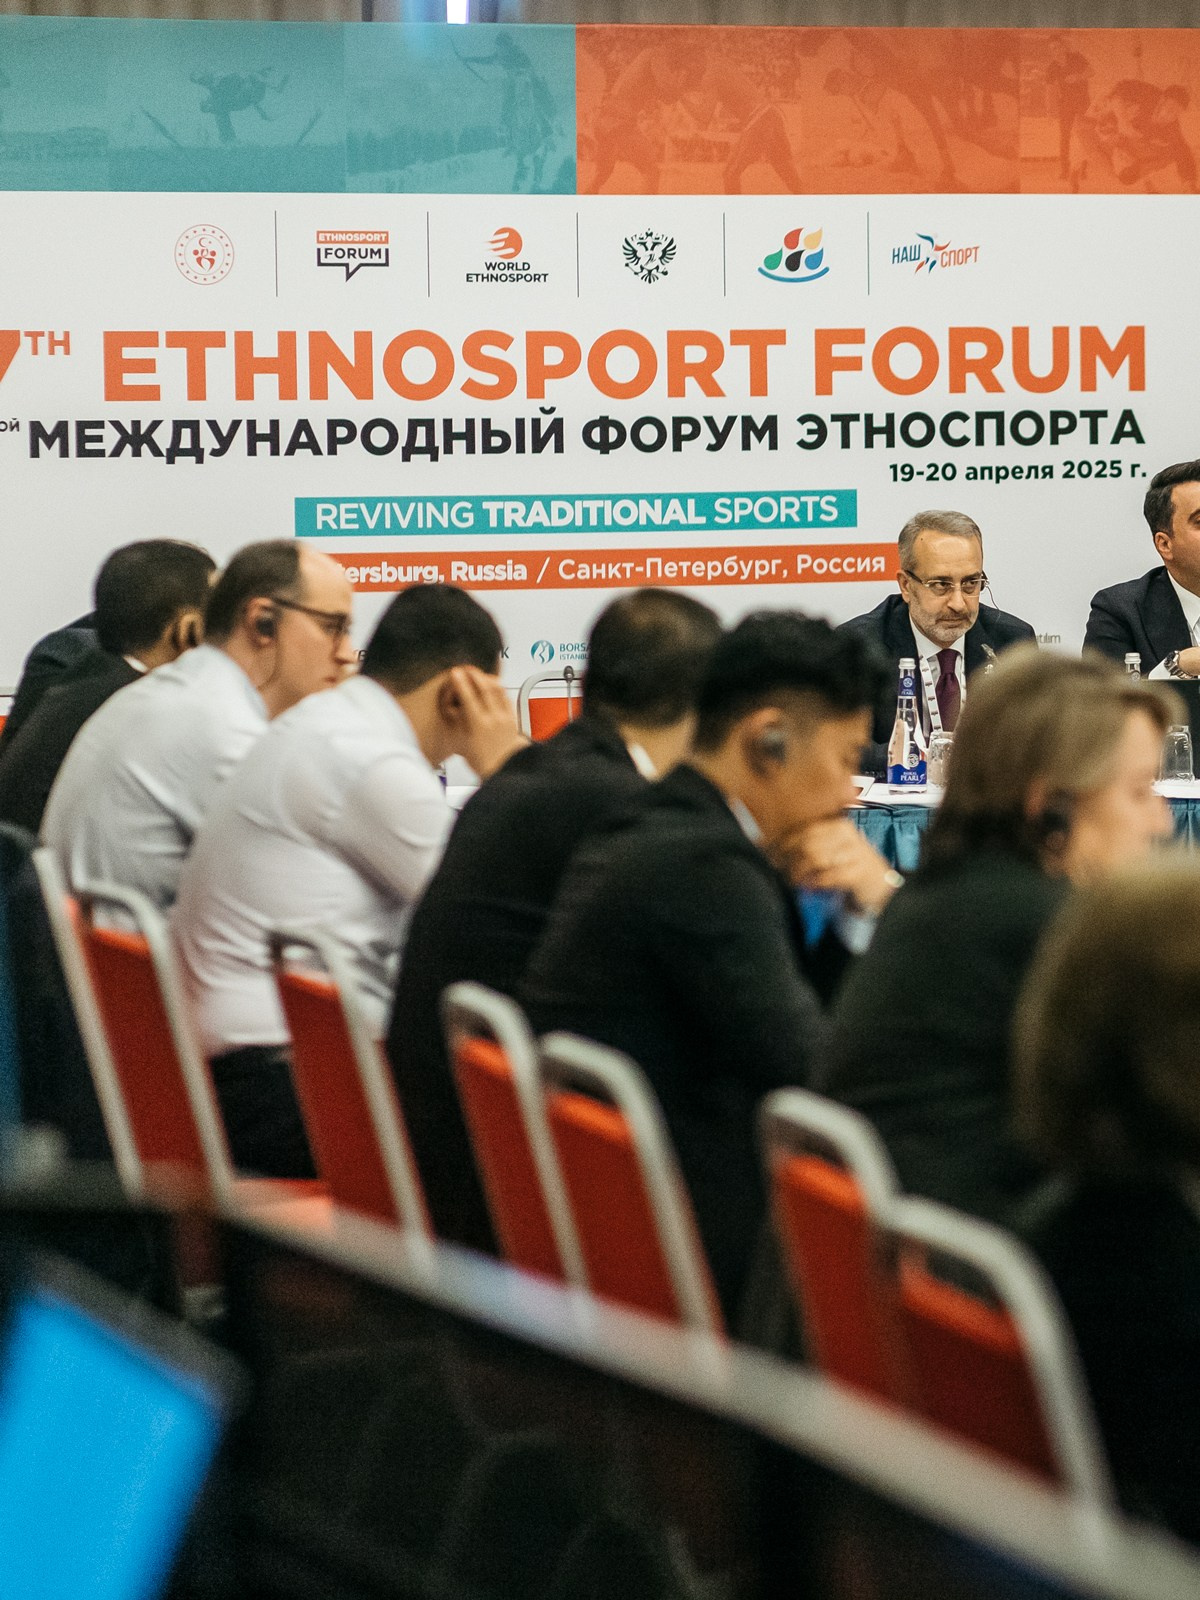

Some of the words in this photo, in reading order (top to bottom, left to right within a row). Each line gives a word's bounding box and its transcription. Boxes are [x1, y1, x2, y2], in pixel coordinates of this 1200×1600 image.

[318, 233, 387, 242] ETHNOSPORT
[325, 247, 382, 259] FORUM
[892, 244, 921, 264] НАШ
[940, 246, 980, 268] СПОРТ
[466, 273, 549, 283] ETHNOSPORT
[485, 262, 531, 271] WORLD
[103, 329, 787, 402] ETHNOSPORT
[814, 325, 1146, 397] FORUM
[28, 407, 565, 465] МЕЖДУНАРОДНЫЙ
[581, 415, 779, 455] ФОРУМ
[796, 409, 1145, 451] ЭТНОСПОРТА
[889, 462, 957, 482] 19-20
[965, 464, 1053, 484] апреля
[1062, 460, 1122, 479] 2025
[1131, 464, 1148, 478] г.
[316, 502, 474, 529] REVIVING
[482, 498, 706, 528] TRADITIONAL
[714, 495, 839, 524] SPORTS
[342, 561, 445, 584] ersburg,
[451, 560, 528, 581] Russia
[558, 556, 788, 580] Санкт-Петербург,
[797, 555, 886, 575] Россия
